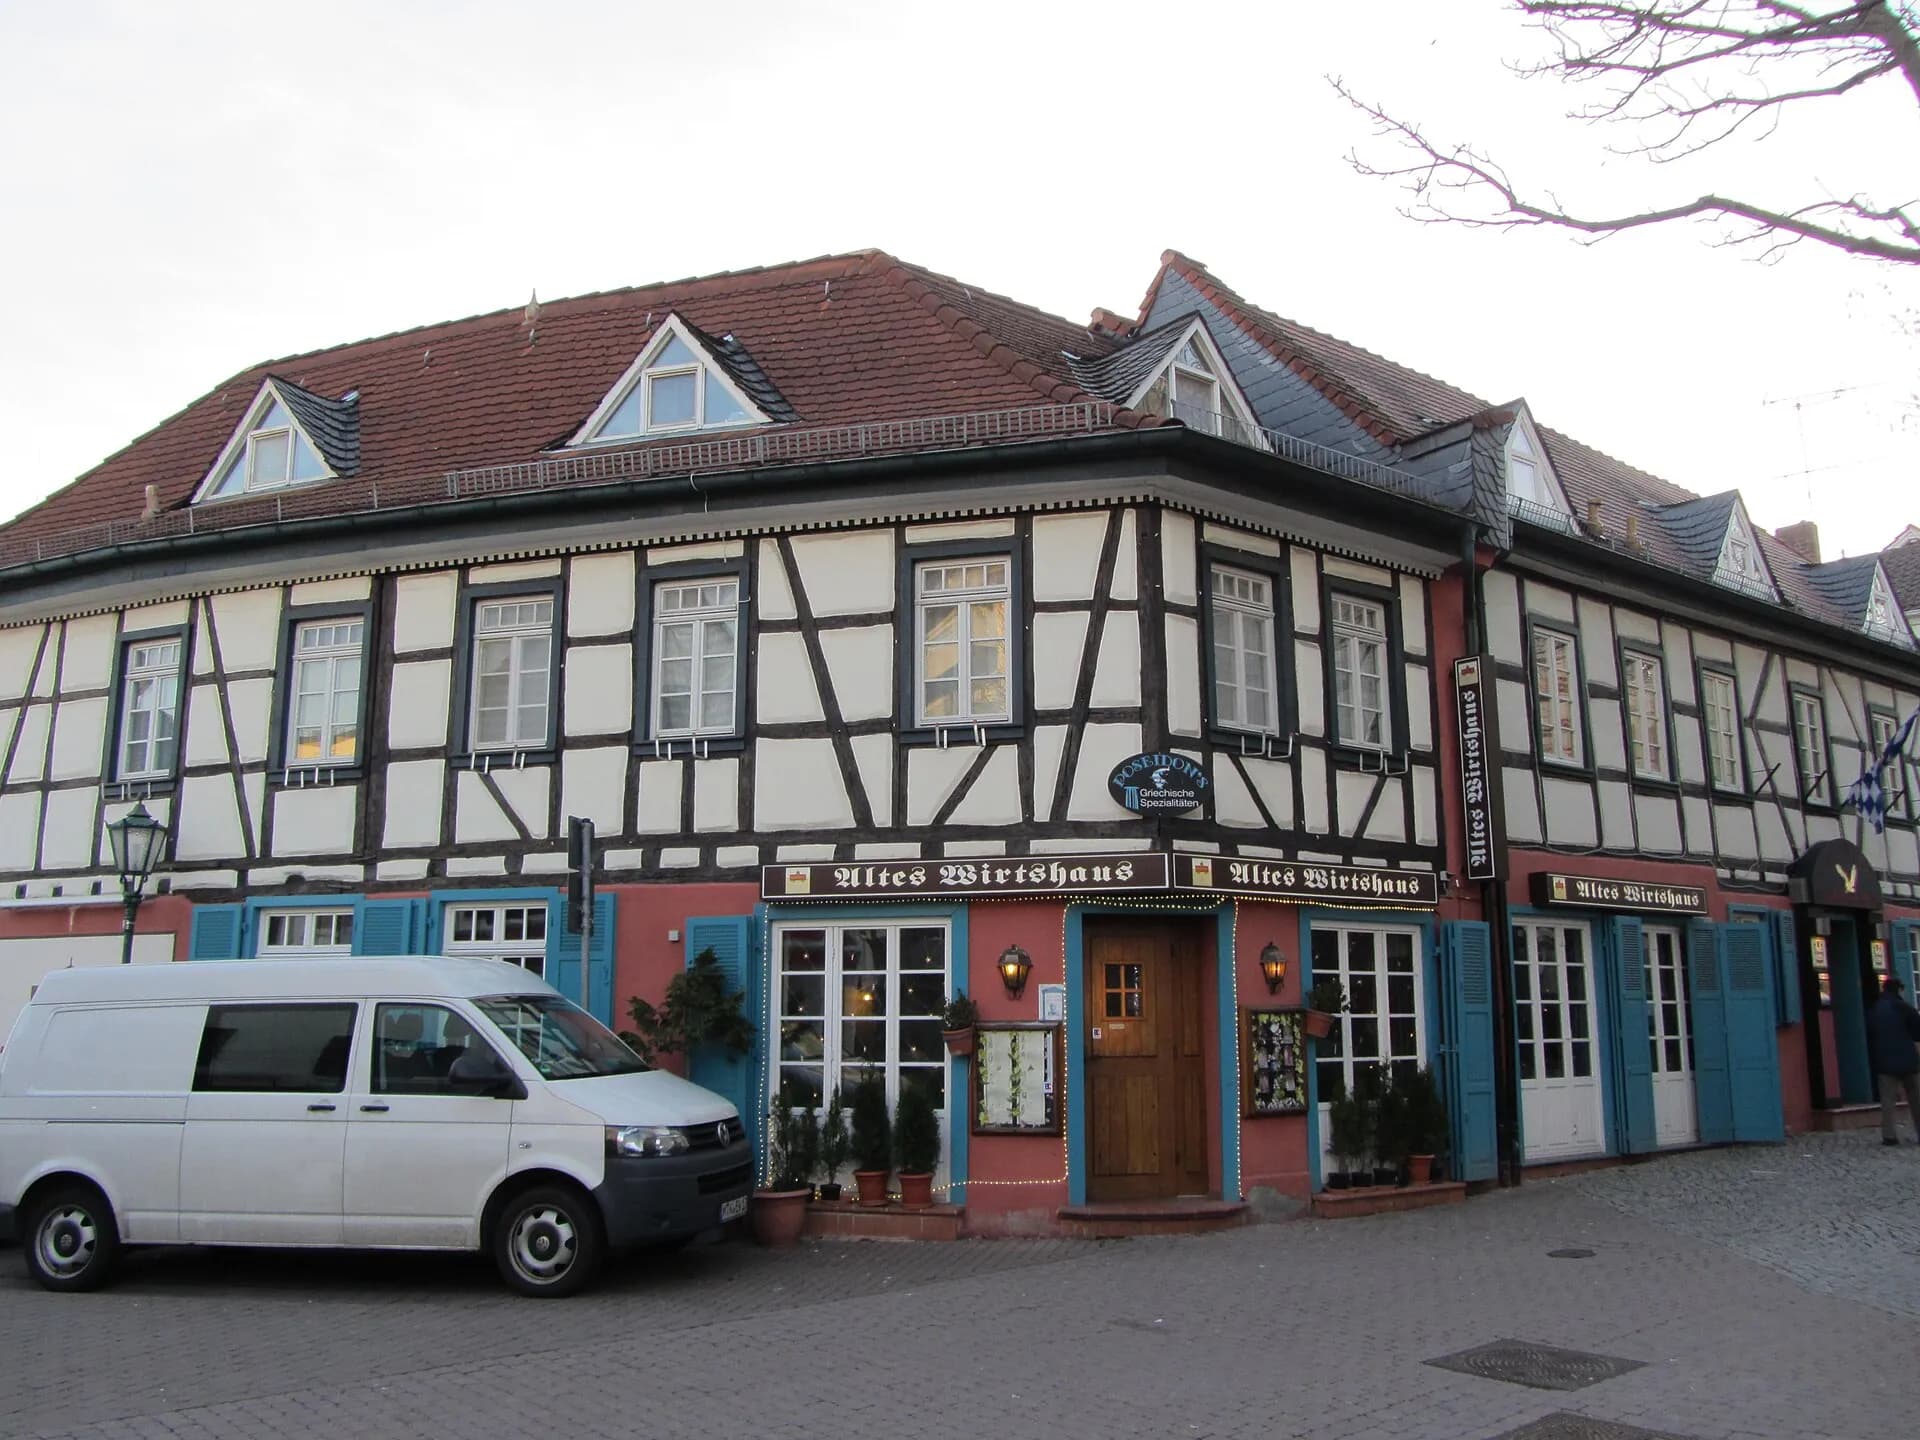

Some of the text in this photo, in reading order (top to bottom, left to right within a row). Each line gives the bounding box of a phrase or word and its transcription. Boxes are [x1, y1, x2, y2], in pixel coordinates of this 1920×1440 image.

[1462, 690, 1486, 867] Altes Wirtshaus
[1140, 789, 1195, 797] Griechische
[1140, 799, 1199, 808] Spezialitäten
[834, 860, 1134, 888] Altes Wirtshaus
[1229, 862, 1420, 896] Altes Wirtshaus
[1576, 880, 1700, 907] Altes Wirtshaus
